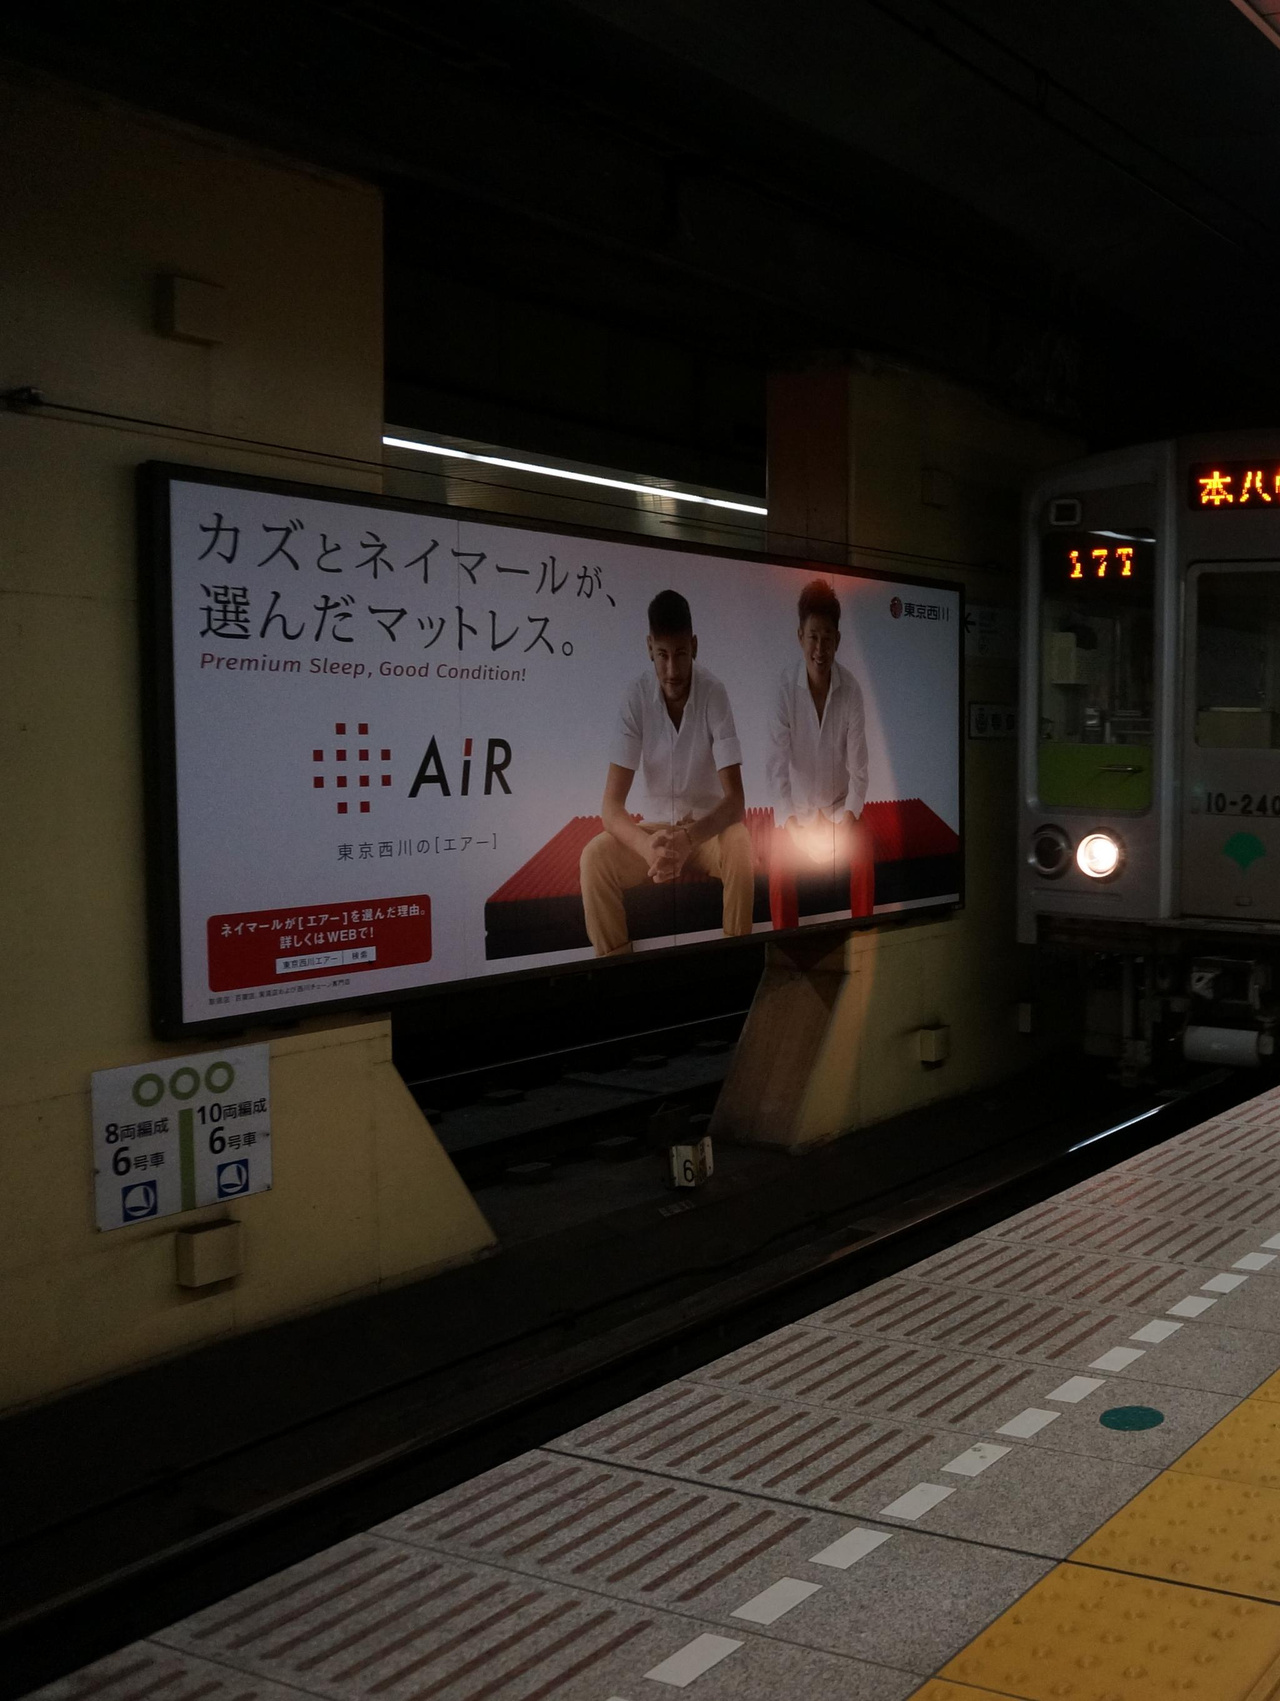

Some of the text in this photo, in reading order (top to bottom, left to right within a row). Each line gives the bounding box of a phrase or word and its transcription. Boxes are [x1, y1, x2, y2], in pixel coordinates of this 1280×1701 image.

[197, 512, 617, 608] カズとネイマールが、
[199, 583, 574, 657] 選んだマットレス。
[904, 602, 949, 622] 東京西川
[200, 652, 527, 683] Premium Sleep, Good Condition!
[196, 1097, 268, 1126] 10両編成
[105, 1117, 169, 1144] 8両編成
[209, 1126, 257, 1154] 6号車
[112, 1146, 165, 1176] 6号車
[683, 1159, 694, 1183] 6
